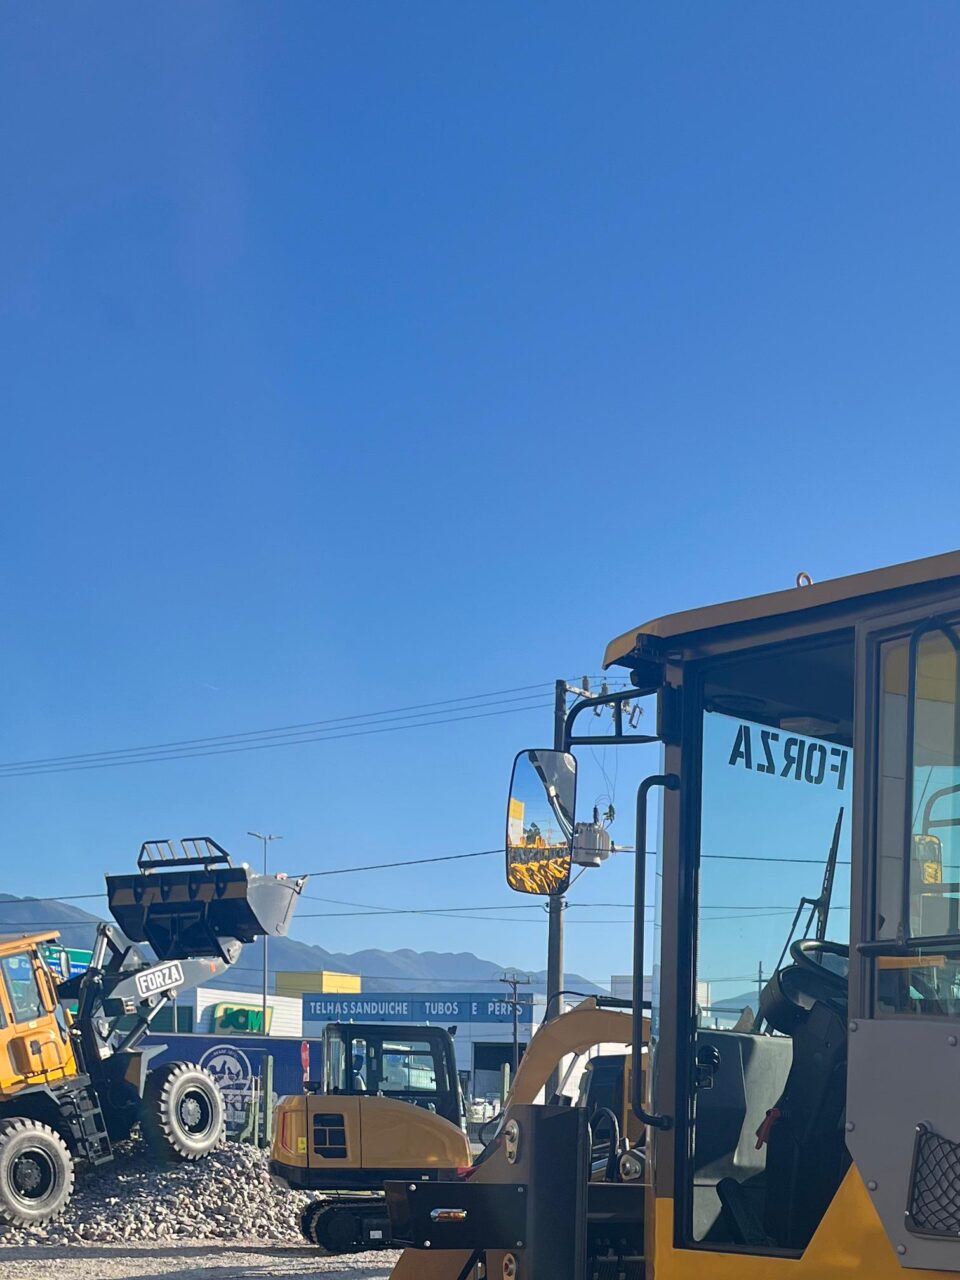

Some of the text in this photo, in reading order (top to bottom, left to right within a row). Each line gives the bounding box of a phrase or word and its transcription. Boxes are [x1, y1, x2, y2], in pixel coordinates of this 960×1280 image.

[139, 965, 181, 993] FORZA
[219, 1007, 263, 1031] JCM
[310, 1002, 523, 1015] TELHAS SANDUICHE TUBOS E PERFS
